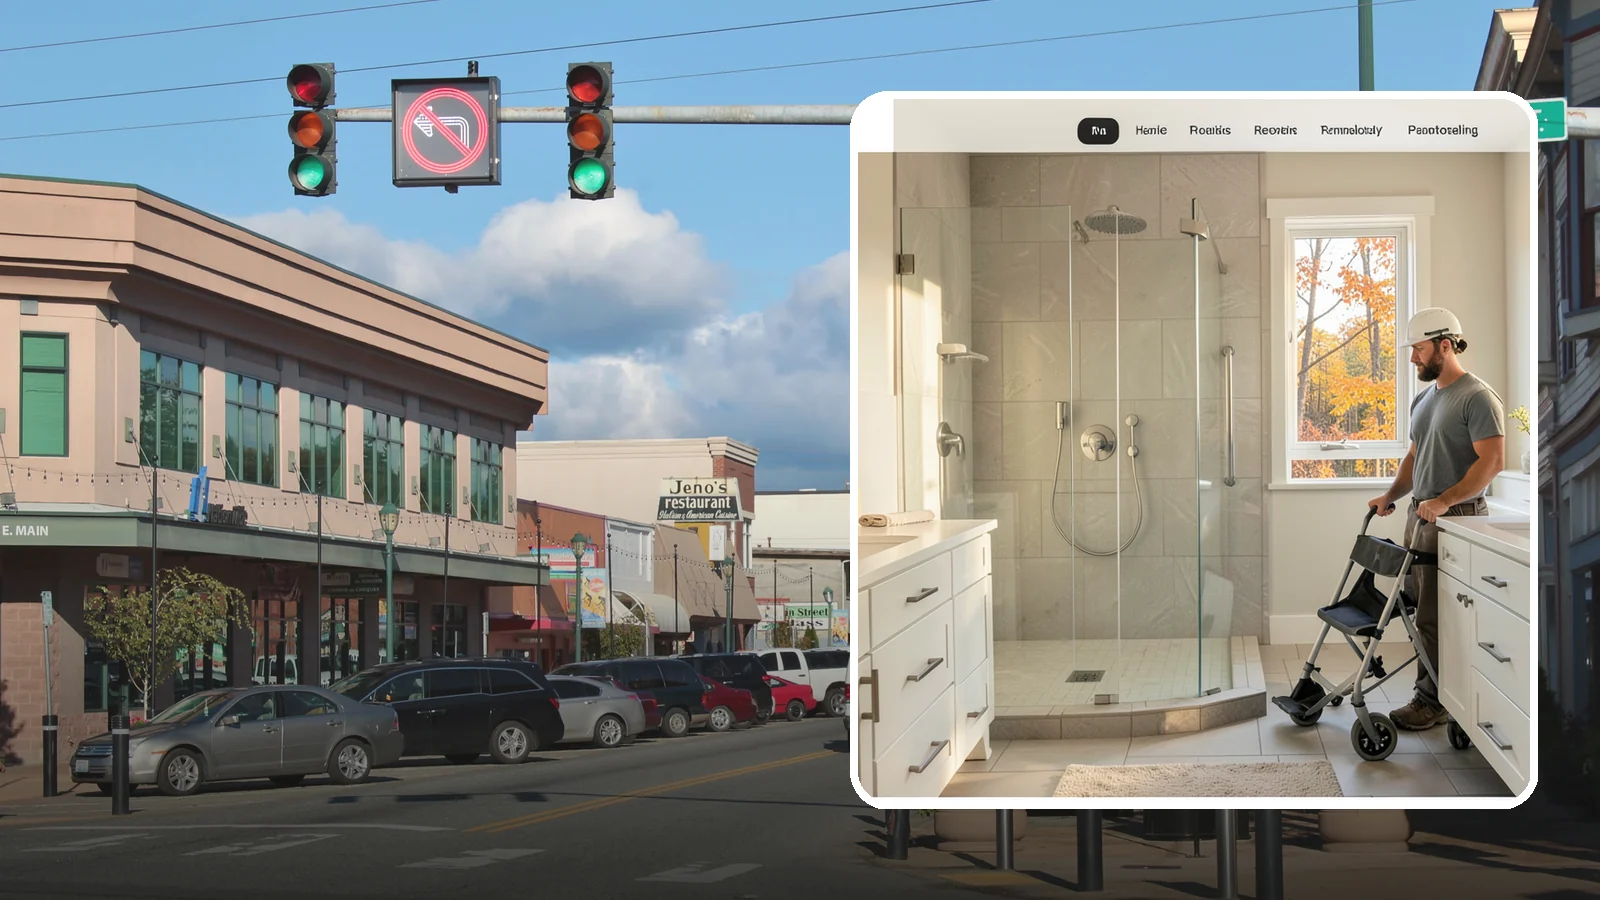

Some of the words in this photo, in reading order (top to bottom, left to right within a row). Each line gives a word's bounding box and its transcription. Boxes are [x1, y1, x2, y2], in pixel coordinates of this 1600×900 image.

[669, 480, 728, 495] Jeno's
[665, 496, 731, 509] restaurant
[686, 510, 715, 520] American
[715, 510, 738, 520] Cuisine
[2, 525, 13, 536] E.
[15, 525, 49, 536] MAIN
[797, 607, 828, 617] Street
